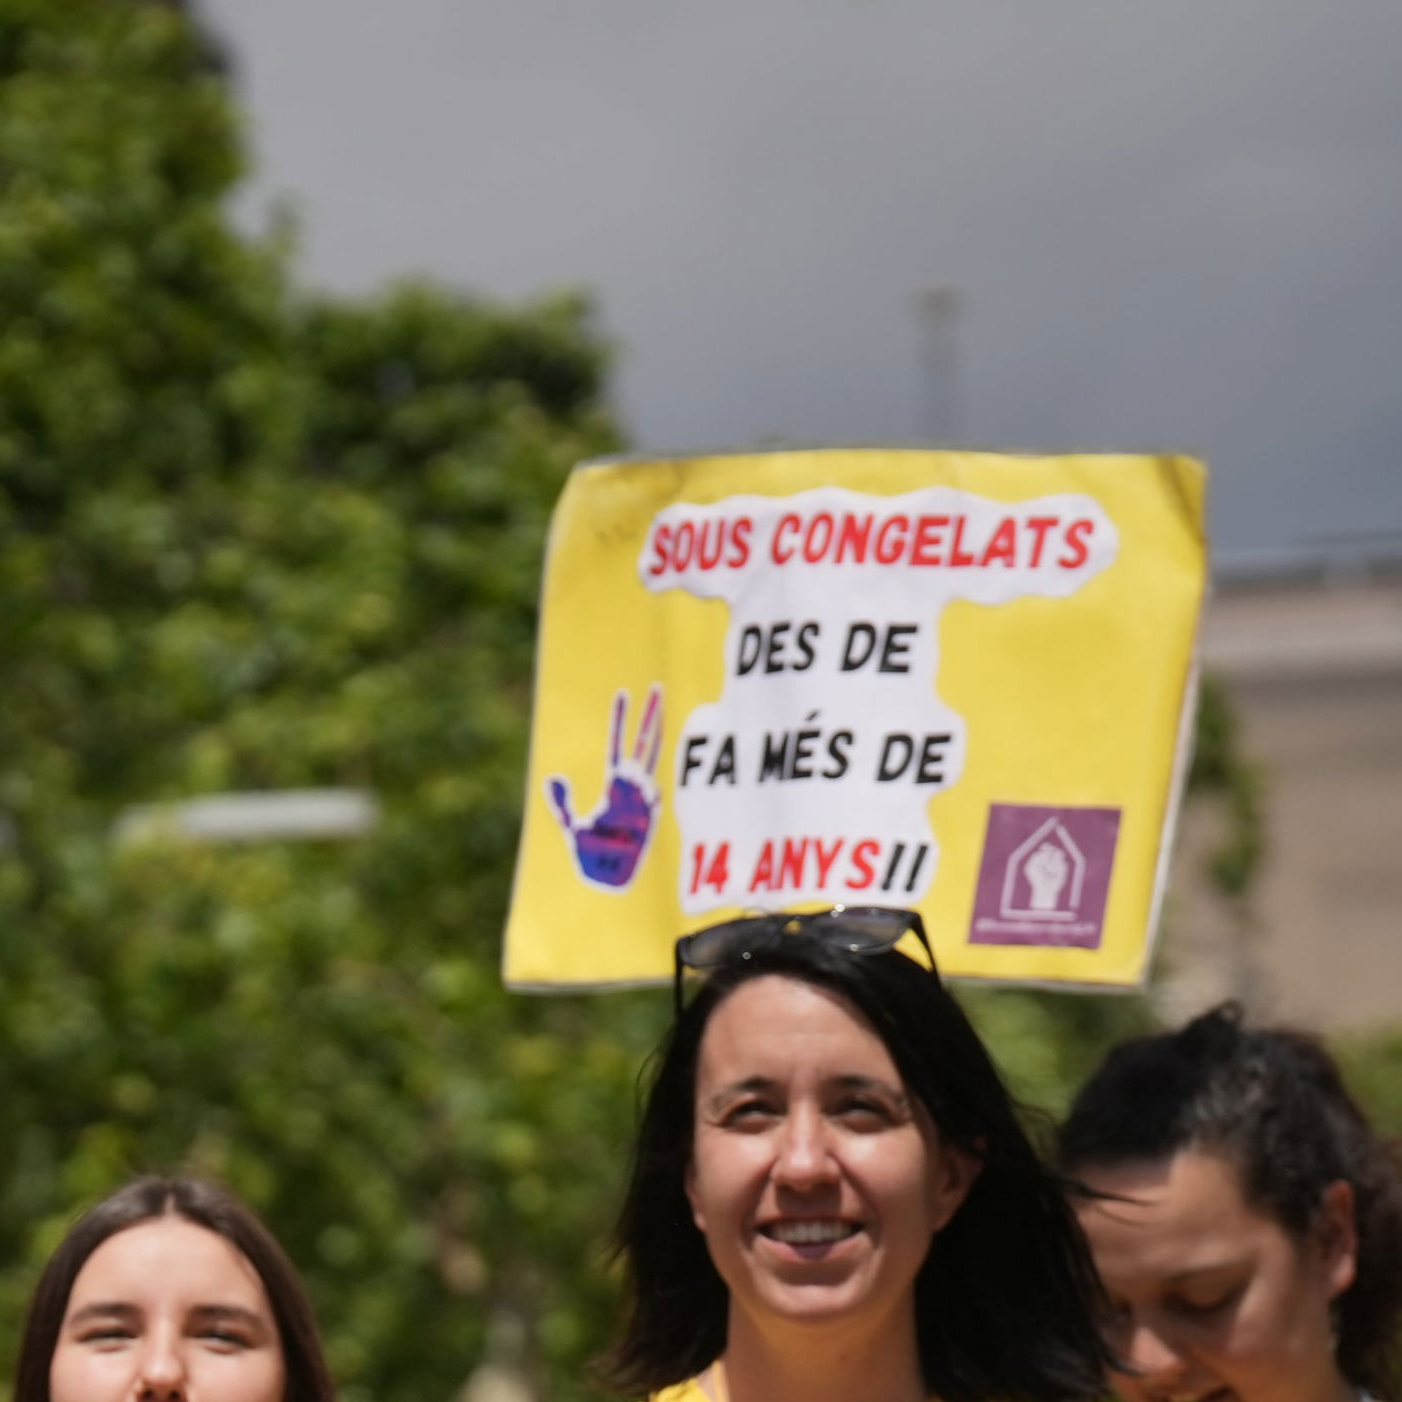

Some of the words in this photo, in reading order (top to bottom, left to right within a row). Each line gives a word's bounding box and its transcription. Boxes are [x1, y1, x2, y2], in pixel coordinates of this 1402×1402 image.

[649, 516, 753, 577] SOUS
[770, 512, 1095, 570] CONGELATS
[736, 621, 821, 677] DES
[840, 622, 919, 675] DE
[680, 735, 737, 787] FA
[757, 710, 854, 784] MÉS
[876, 733, 952, 785] DE
[689, 842, 728, 894] 14
